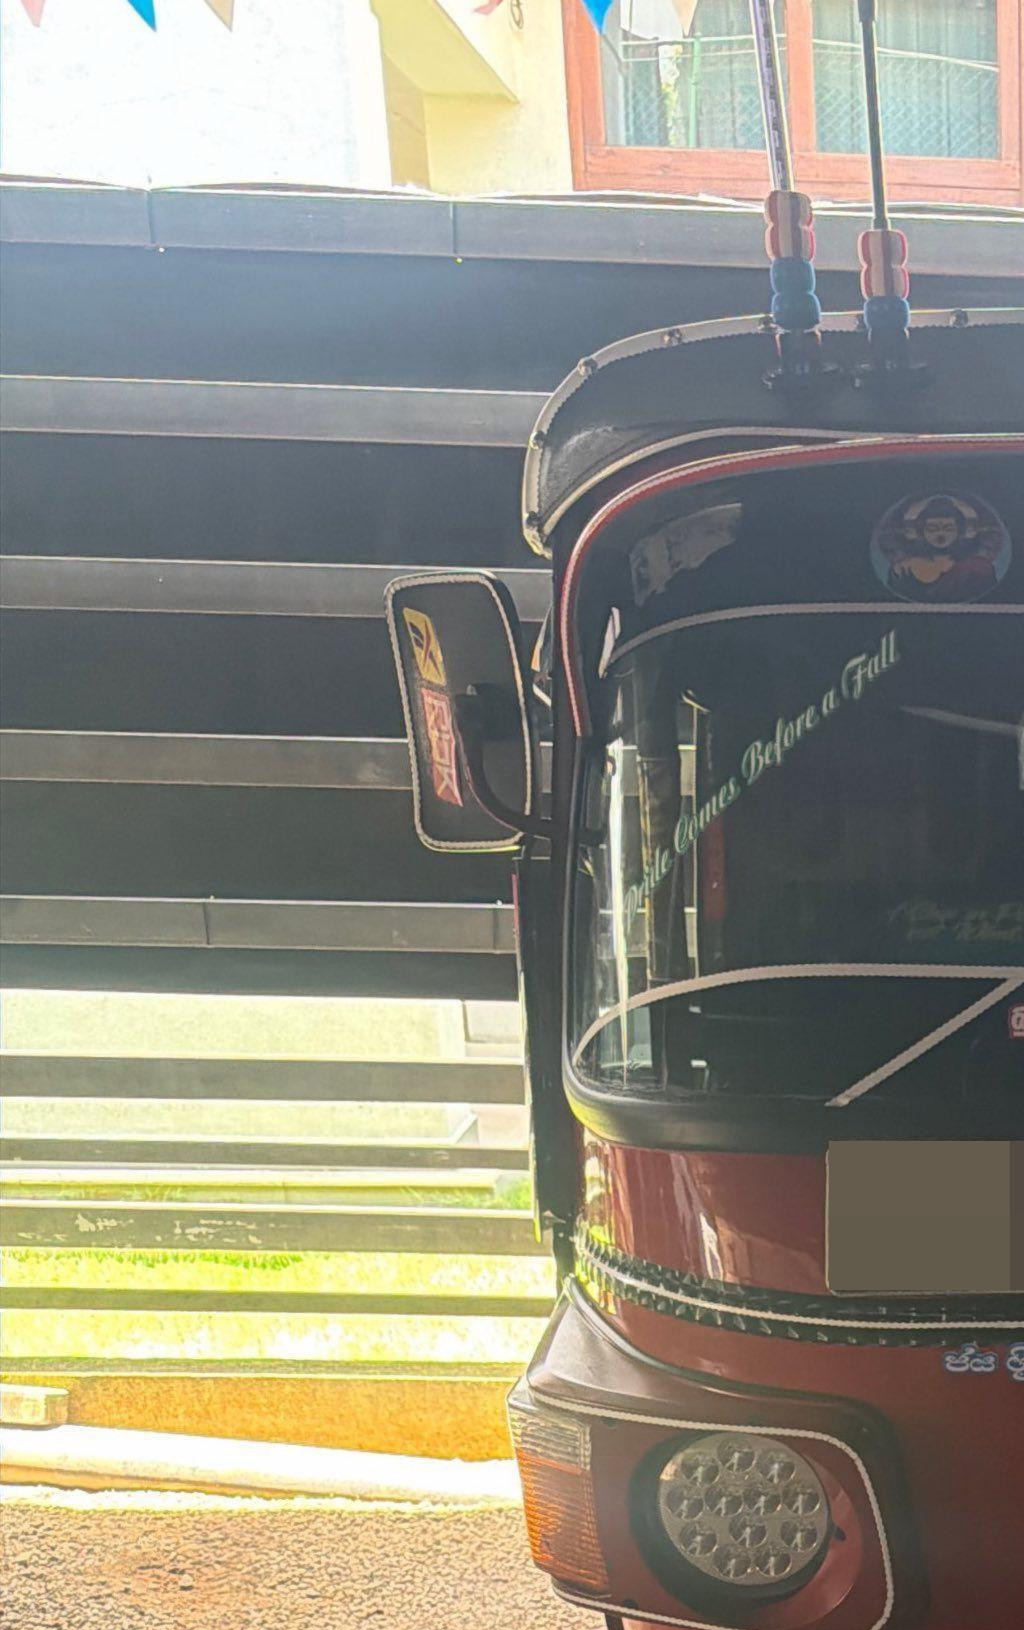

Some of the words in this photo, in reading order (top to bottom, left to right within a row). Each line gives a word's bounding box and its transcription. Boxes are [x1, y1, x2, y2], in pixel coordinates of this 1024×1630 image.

[741, 704, 819, 786] Before
[821, 687, 840, 718] a
[841, 629, 900, 699] Fall
